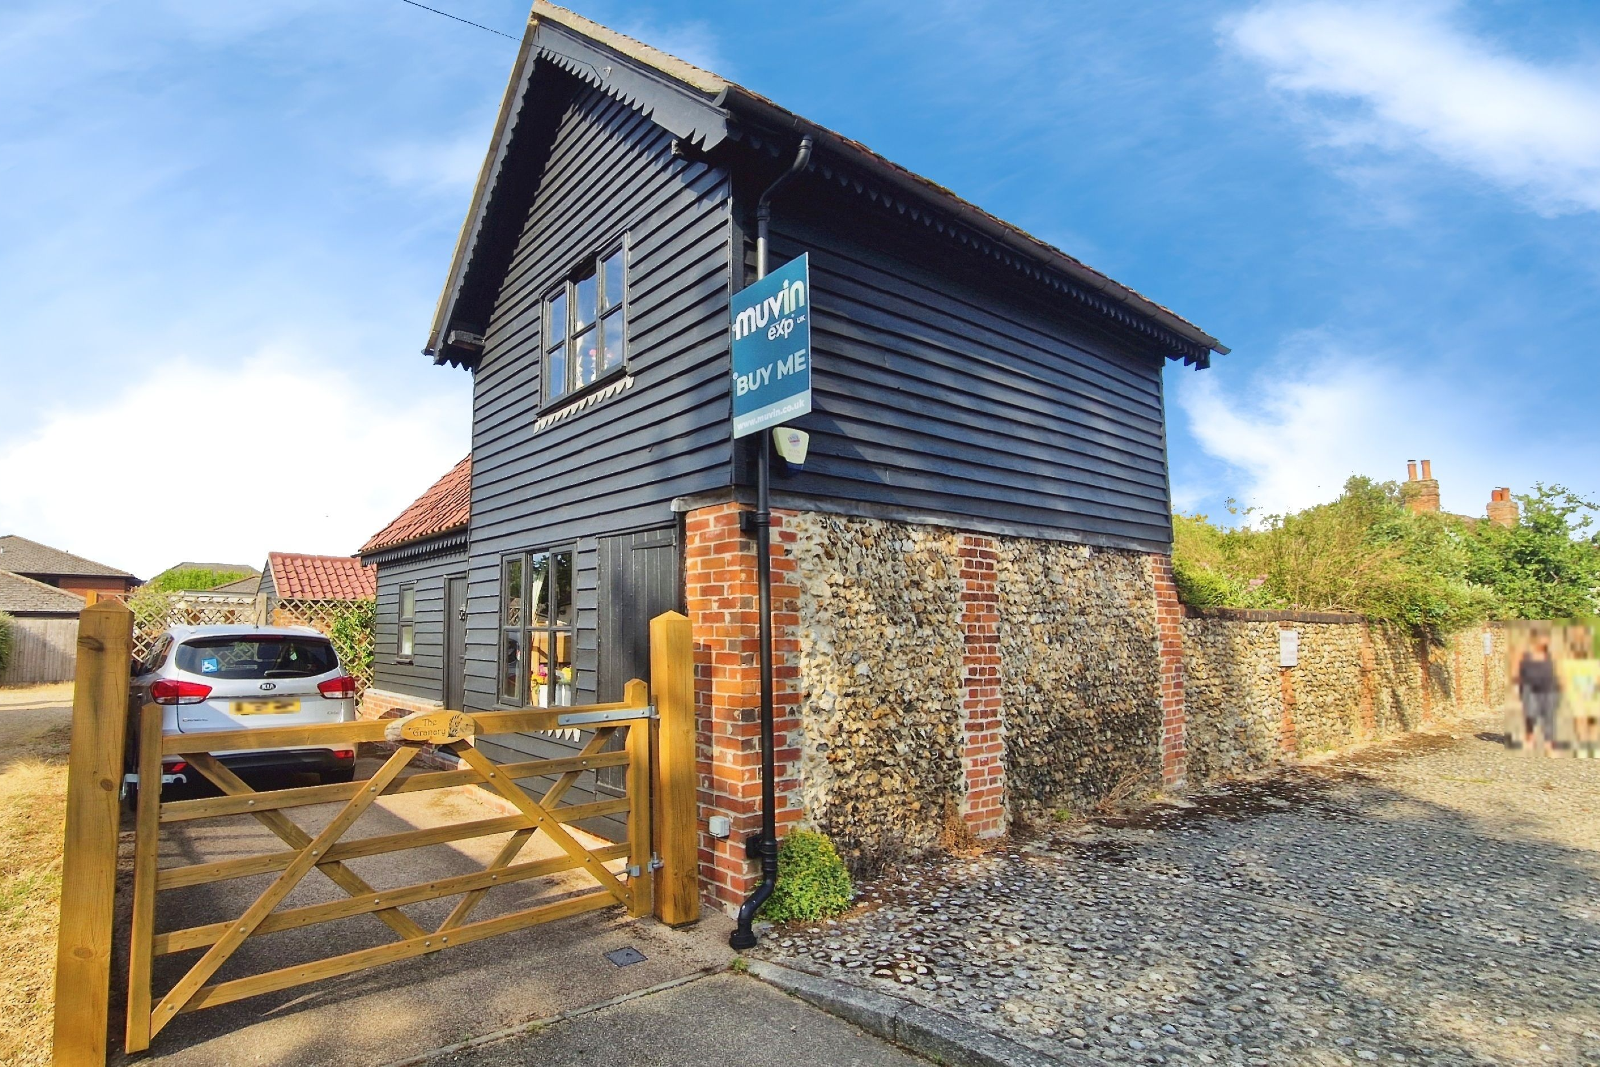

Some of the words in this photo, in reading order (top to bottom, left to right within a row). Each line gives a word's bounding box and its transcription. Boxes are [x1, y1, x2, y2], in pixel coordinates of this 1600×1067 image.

[732, 279, 805, 341] muvin
[736, 362, 773, 397] BUY
[777, 348, 807, 381] ME
[737, 399, 805, 431] www.muvin.co.uk
[412, 727, 446, 737] Granary
[423, 718, 437, 727] The
